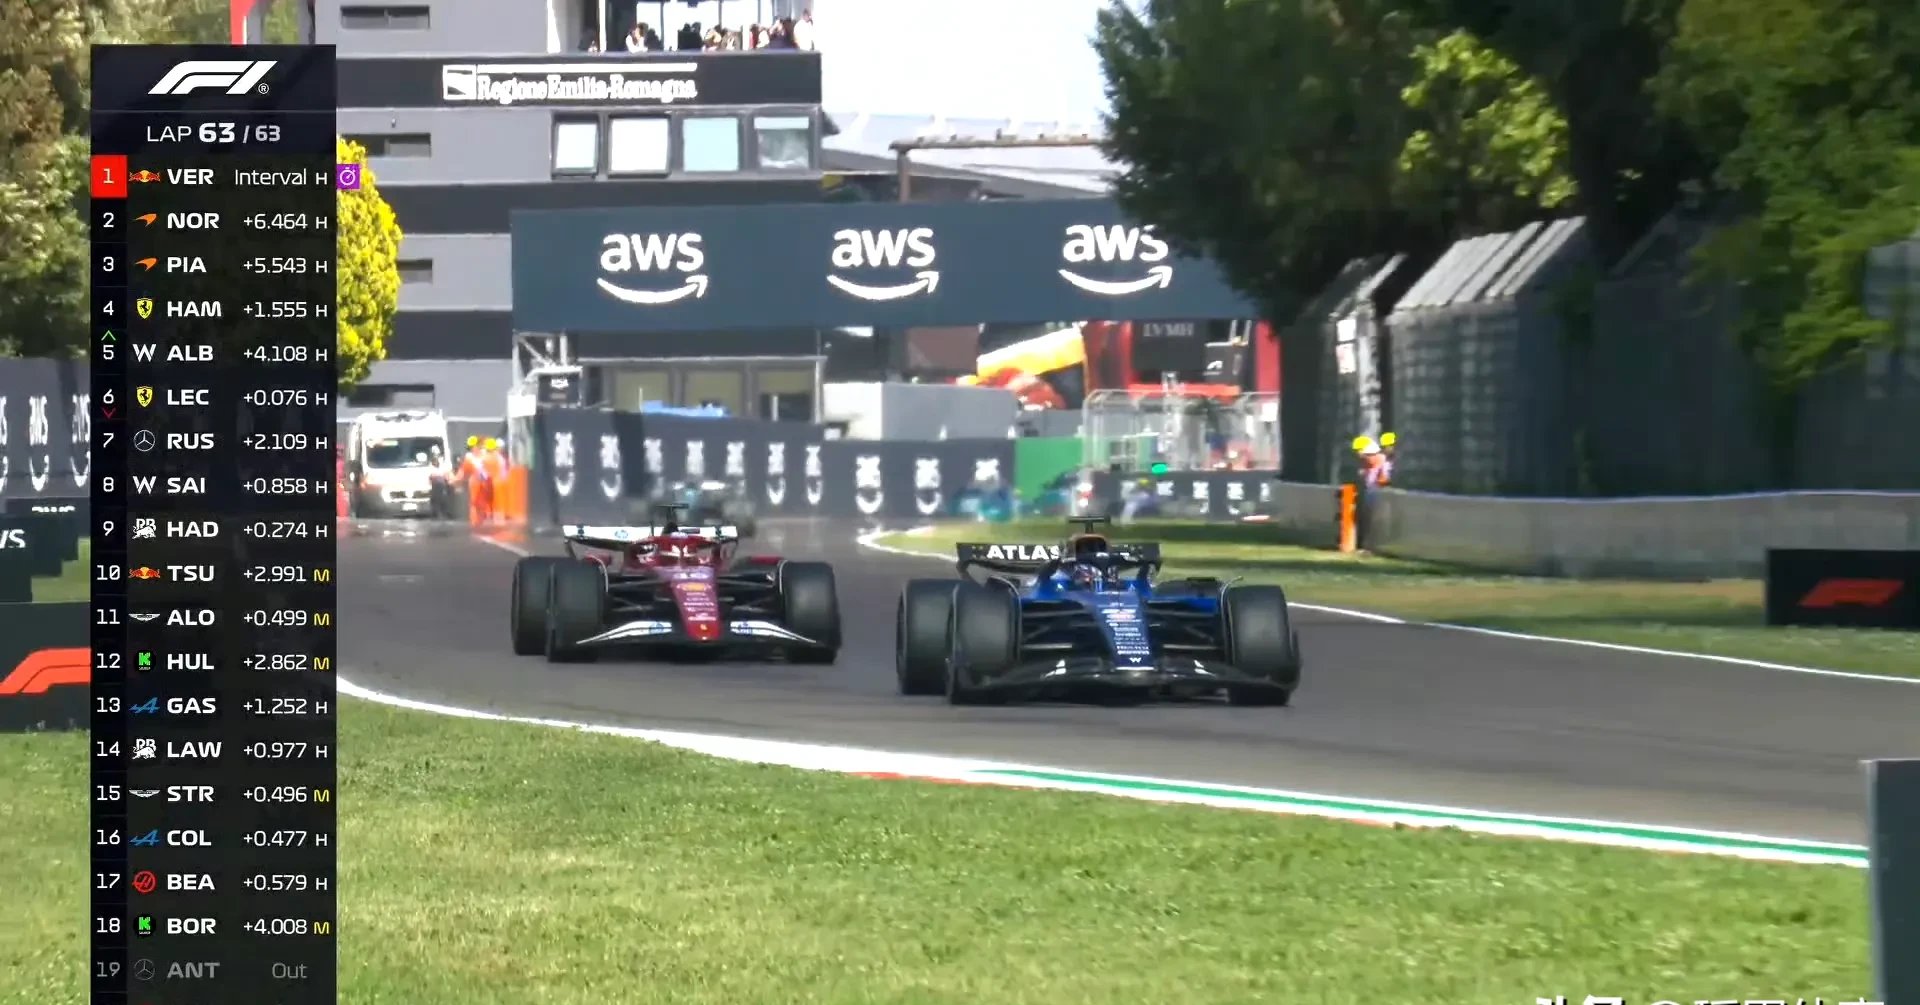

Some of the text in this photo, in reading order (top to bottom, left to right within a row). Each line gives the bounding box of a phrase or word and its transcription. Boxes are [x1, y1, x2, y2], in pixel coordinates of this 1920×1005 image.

[600, 232, 705, 272] aws
[831, 228, 936, 268] aws
[1062, 224, 1169, 263] aws
